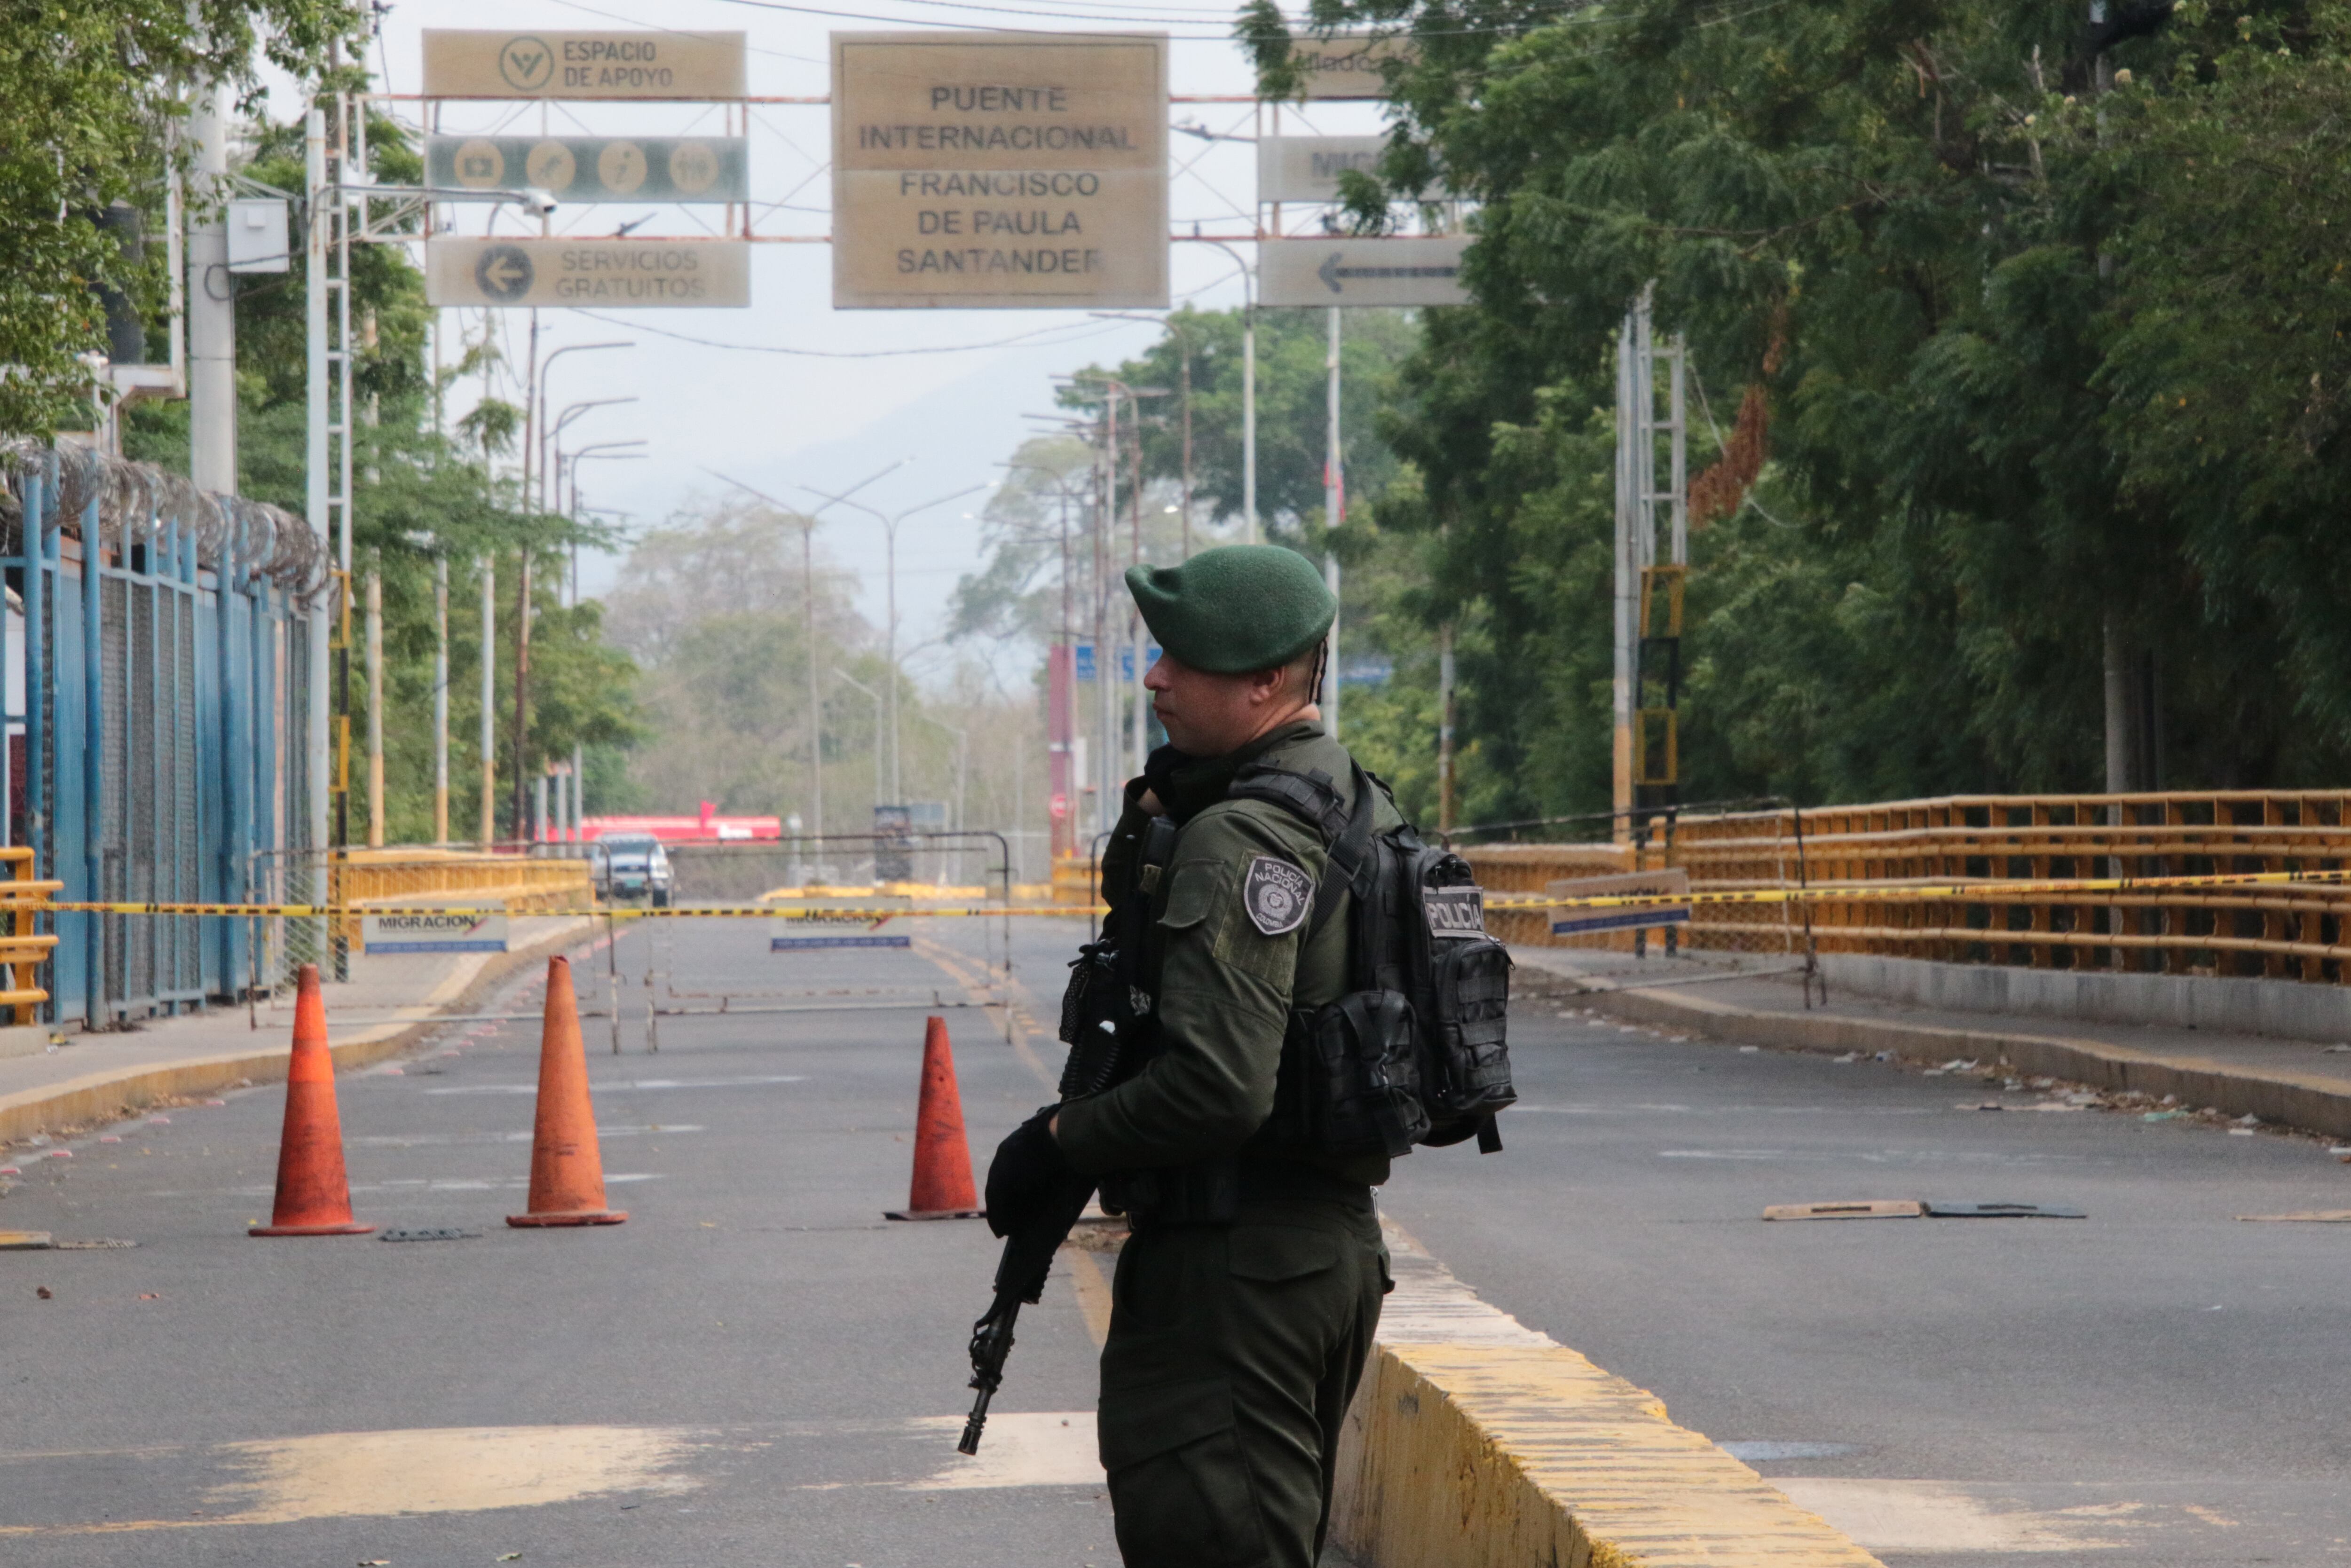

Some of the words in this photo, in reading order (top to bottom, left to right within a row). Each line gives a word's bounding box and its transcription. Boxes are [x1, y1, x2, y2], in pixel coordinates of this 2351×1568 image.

[565, 41, 656, 61] ESPACIO
[566, 67, 593, 87] DE
[599, 68, 672, 87] APOYO
[931, 87, 1068, 111] PUENTE
[859, 125, 1138, 150] INTERNACIONAL
[900, 173, 1100, 196] FRANCISCO
[918, 211, 962, 234] DE
[973, 211, 1081, 235] PAULA
[561, 250, 698, 271] SERVICIOS
[556, 278, 706, 299] GRATUITOS
[1254, 872, 1305, 906] NACIONAL
[1256, 913, 1284, 928] COLOMBIA
[1425, 893, 1482, 930] POLICÍA
